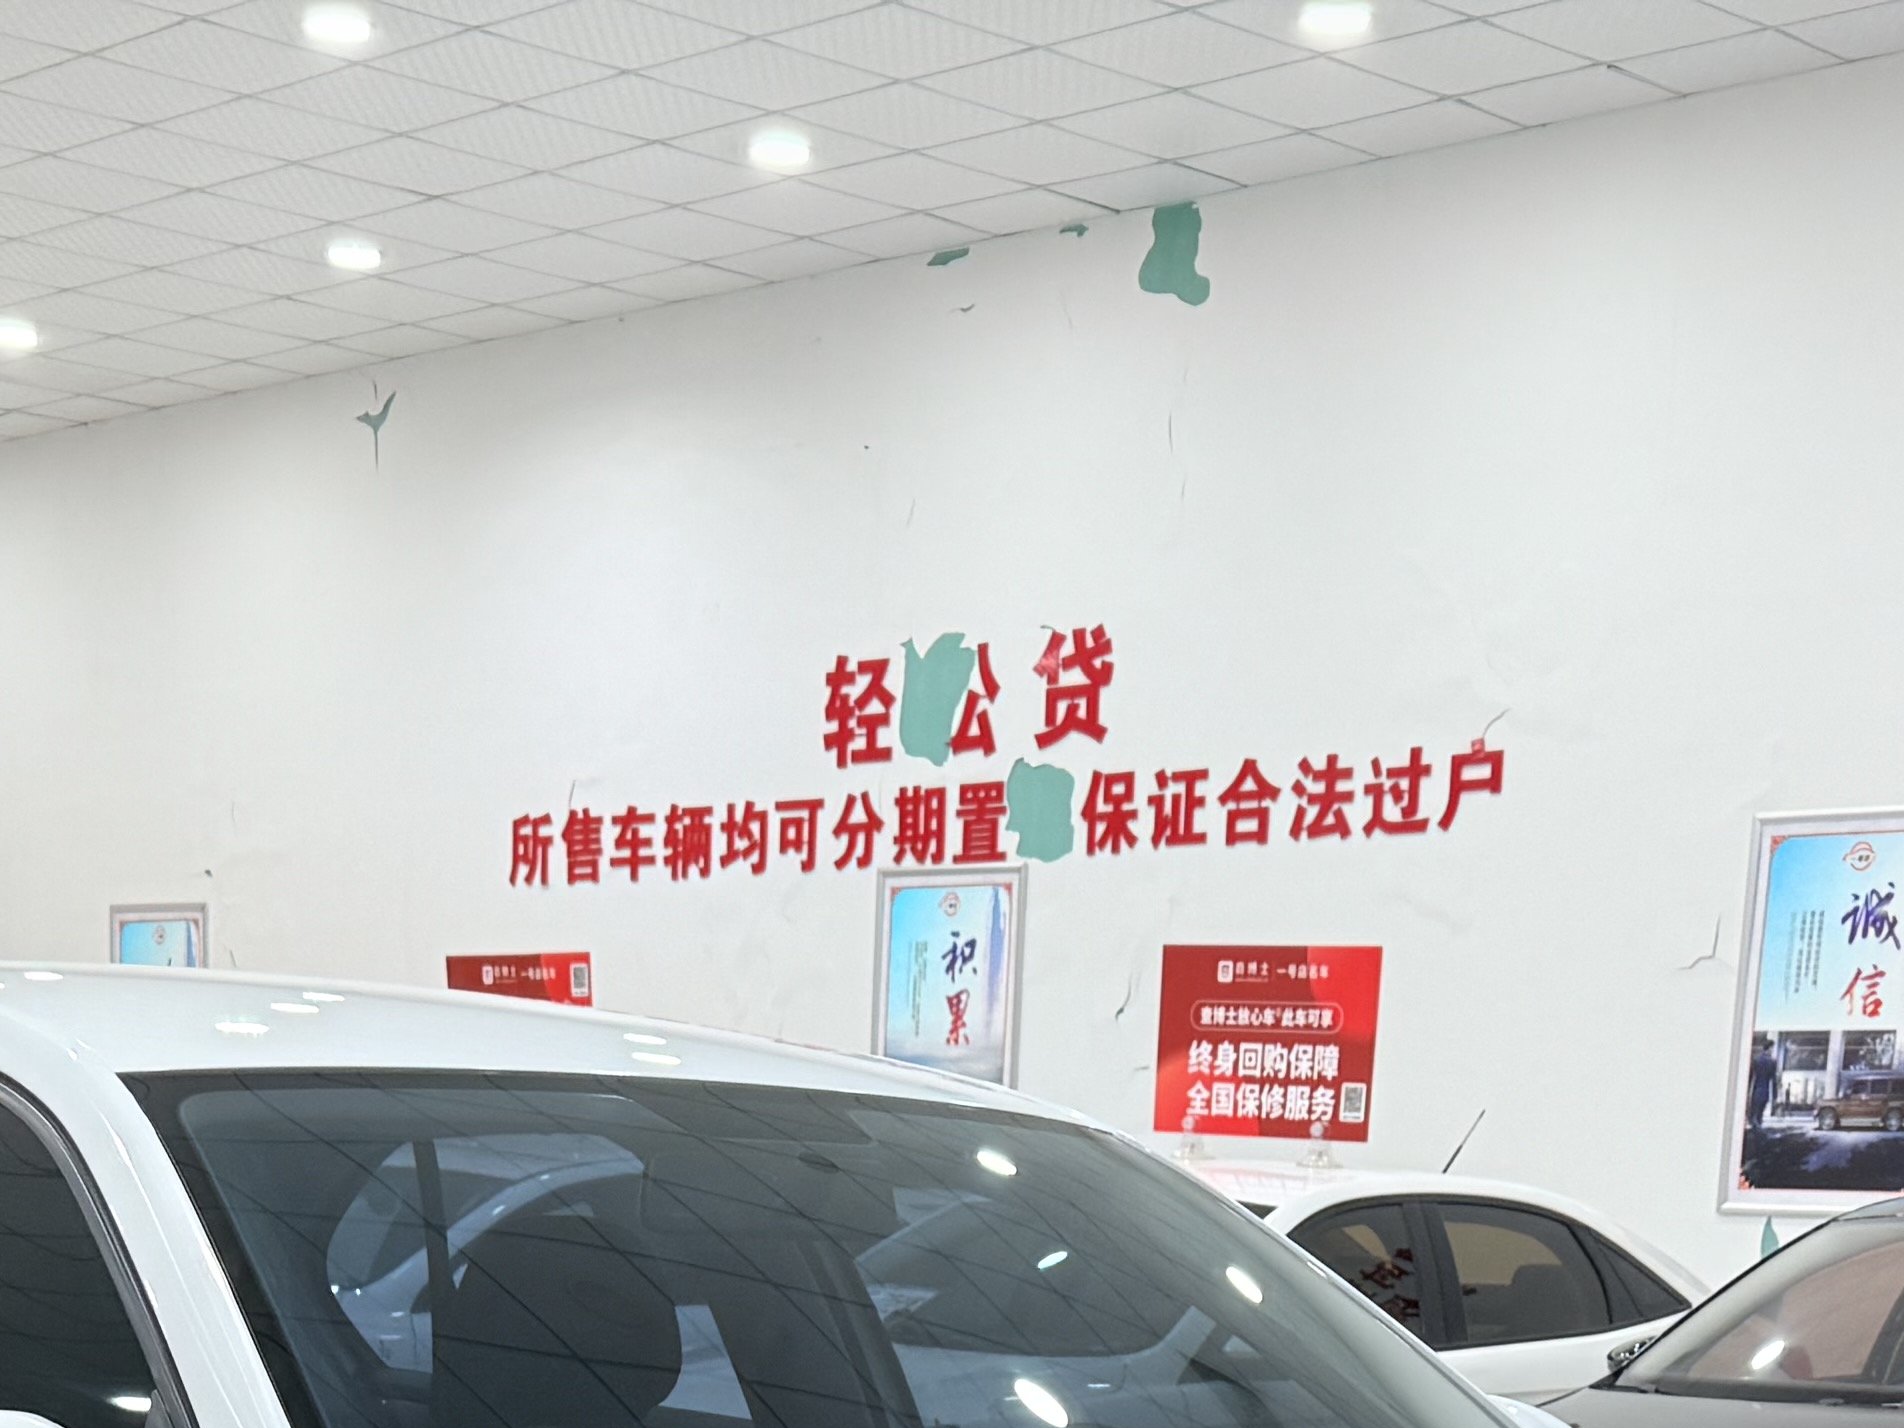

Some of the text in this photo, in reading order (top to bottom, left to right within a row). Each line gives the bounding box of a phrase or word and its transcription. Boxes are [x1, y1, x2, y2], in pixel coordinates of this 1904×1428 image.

[509, 739, 1505, 887] 所售车辆均可分期置保证合法过户
[1187, 1040, 1340, 1081] 终身回购保障
[1186, 1080, 1336, 1122] 全国保修服务
